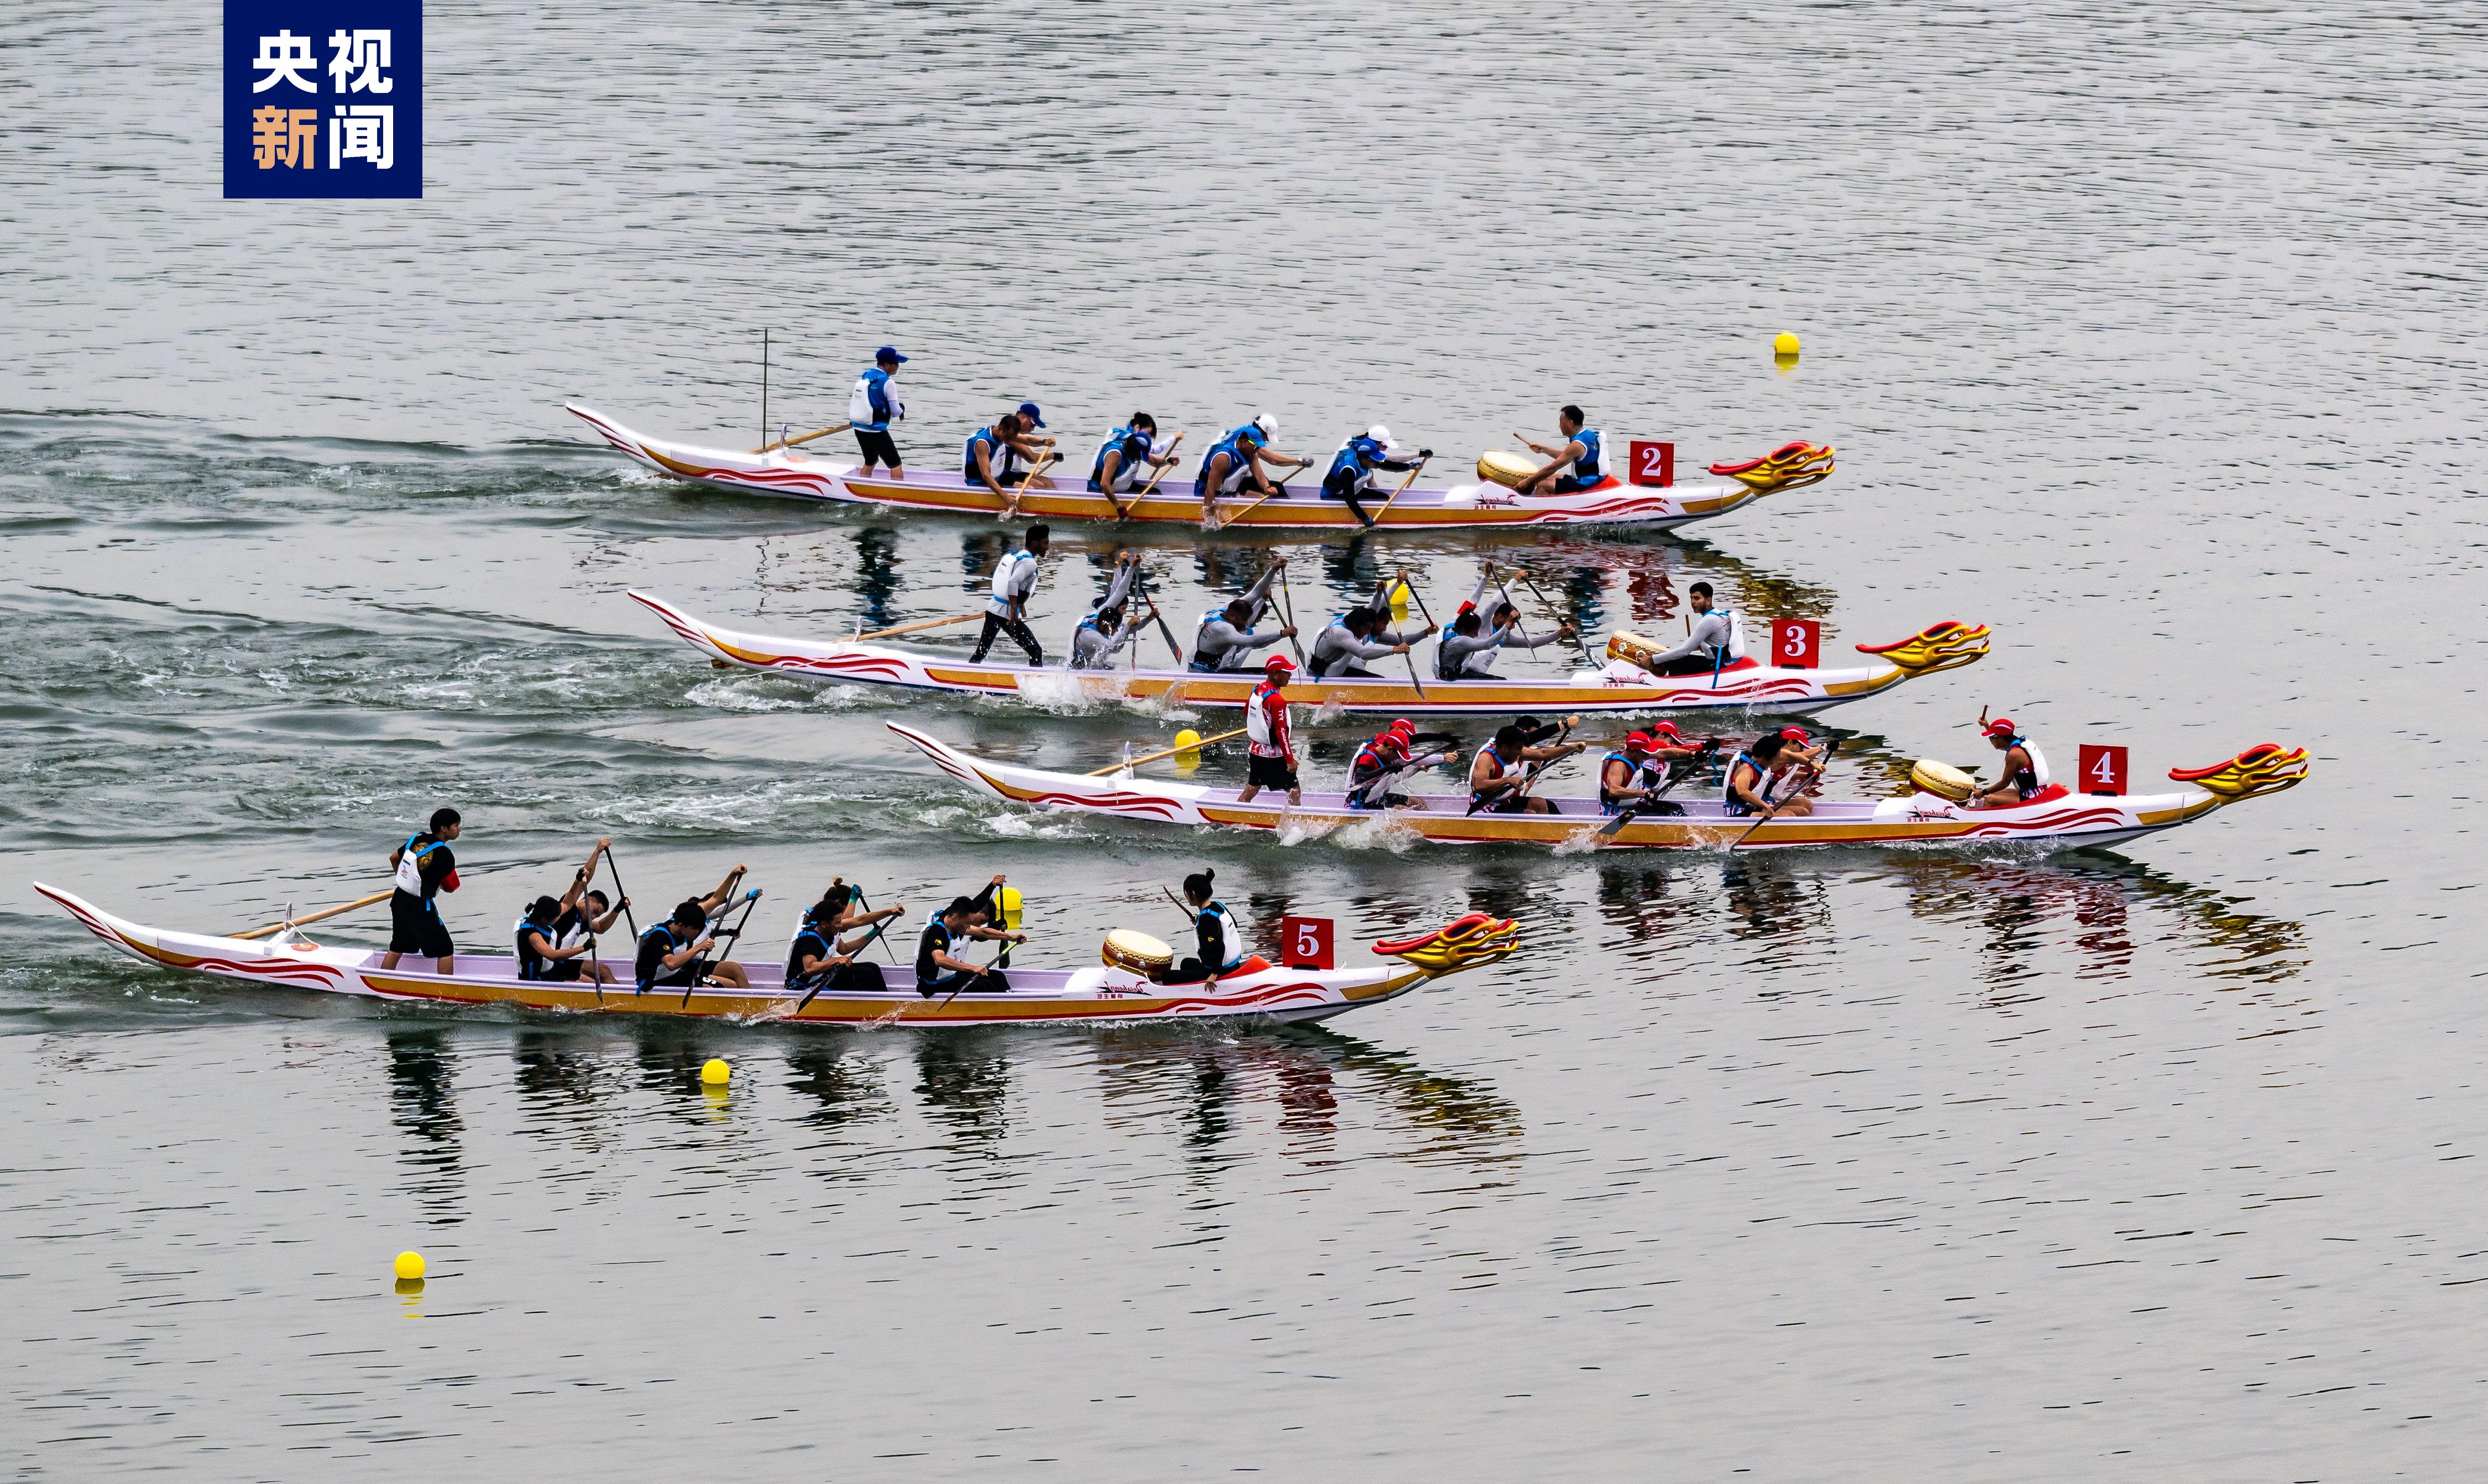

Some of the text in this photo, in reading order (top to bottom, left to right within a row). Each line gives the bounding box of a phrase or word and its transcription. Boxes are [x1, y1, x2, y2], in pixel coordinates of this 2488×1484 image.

[1642, 447, 1661, 477] 2
[1785, 626, 1806, 656] 3
[2092, 751, 2115, 783] 4
[1297, 924, 1319, 957] 5
